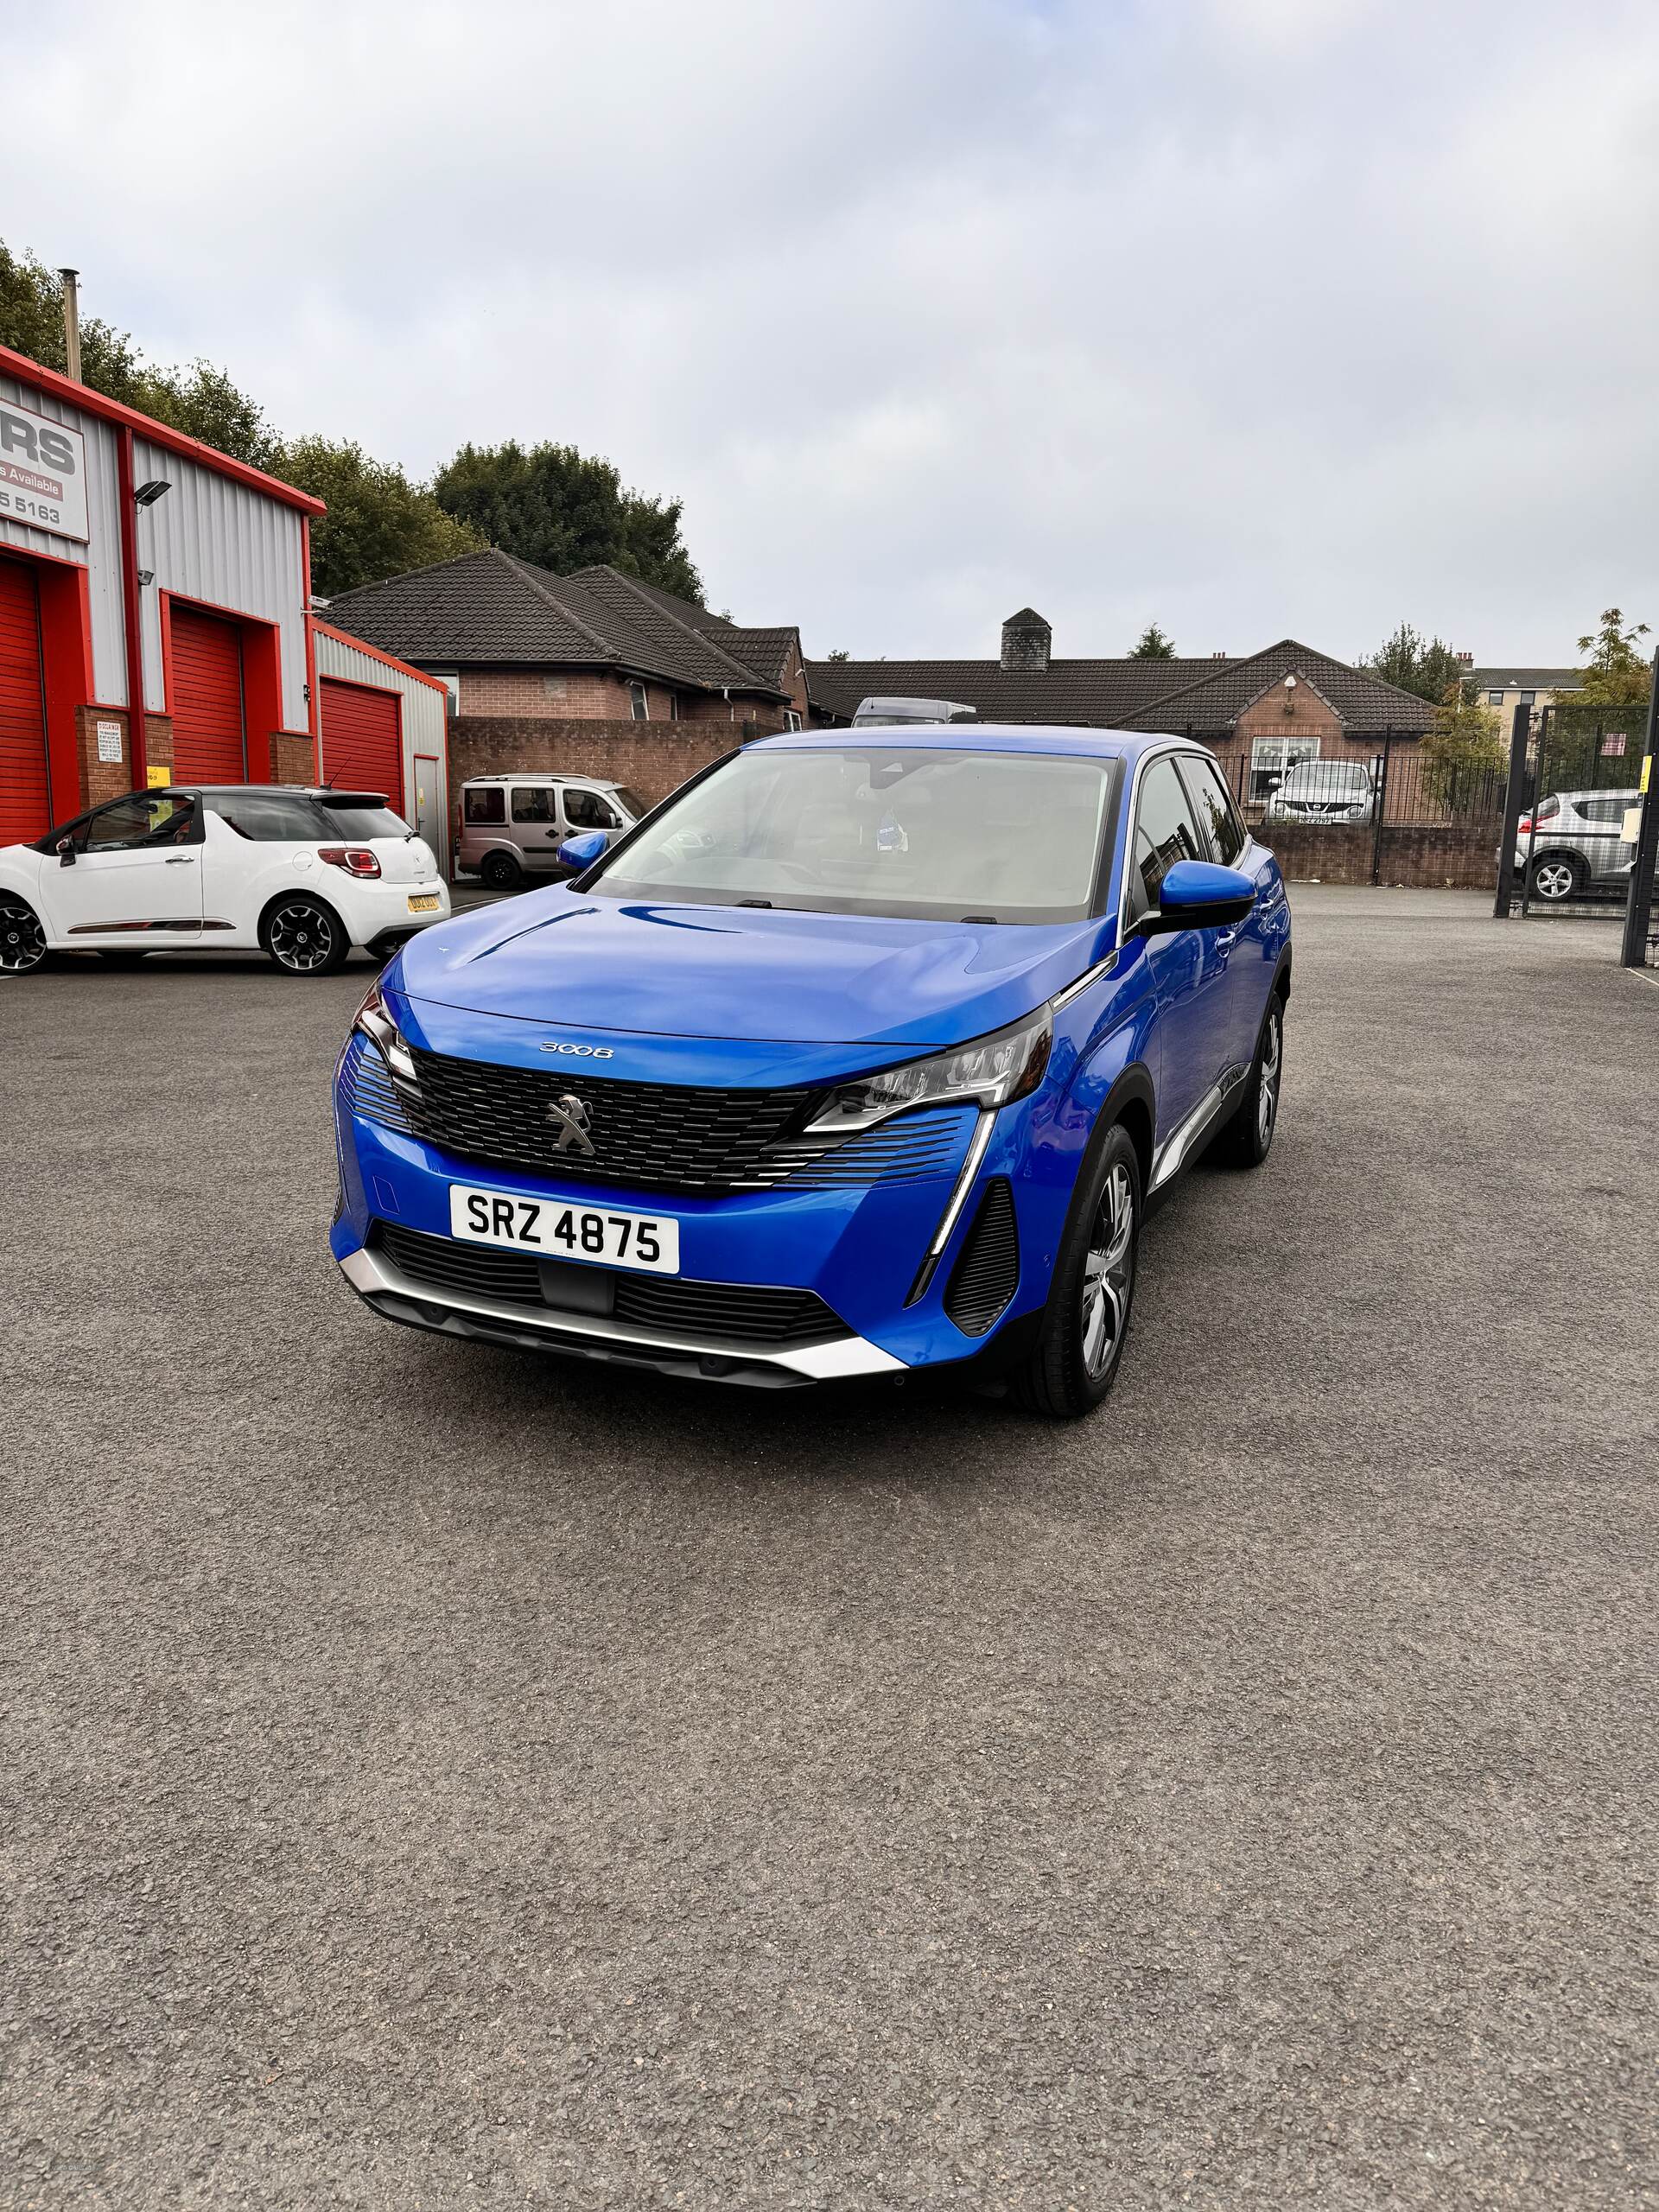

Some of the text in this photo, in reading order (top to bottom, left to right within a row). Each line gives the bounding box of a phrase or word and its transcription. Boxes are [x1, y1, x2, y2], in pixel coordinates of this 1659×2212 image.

[10, 468, 60, 495] Available
[15, 496, 60, 524] 5163
[539, 1041, 615, 1059] 3008
[467, 1194, 661, 1263] SRZ 4875
